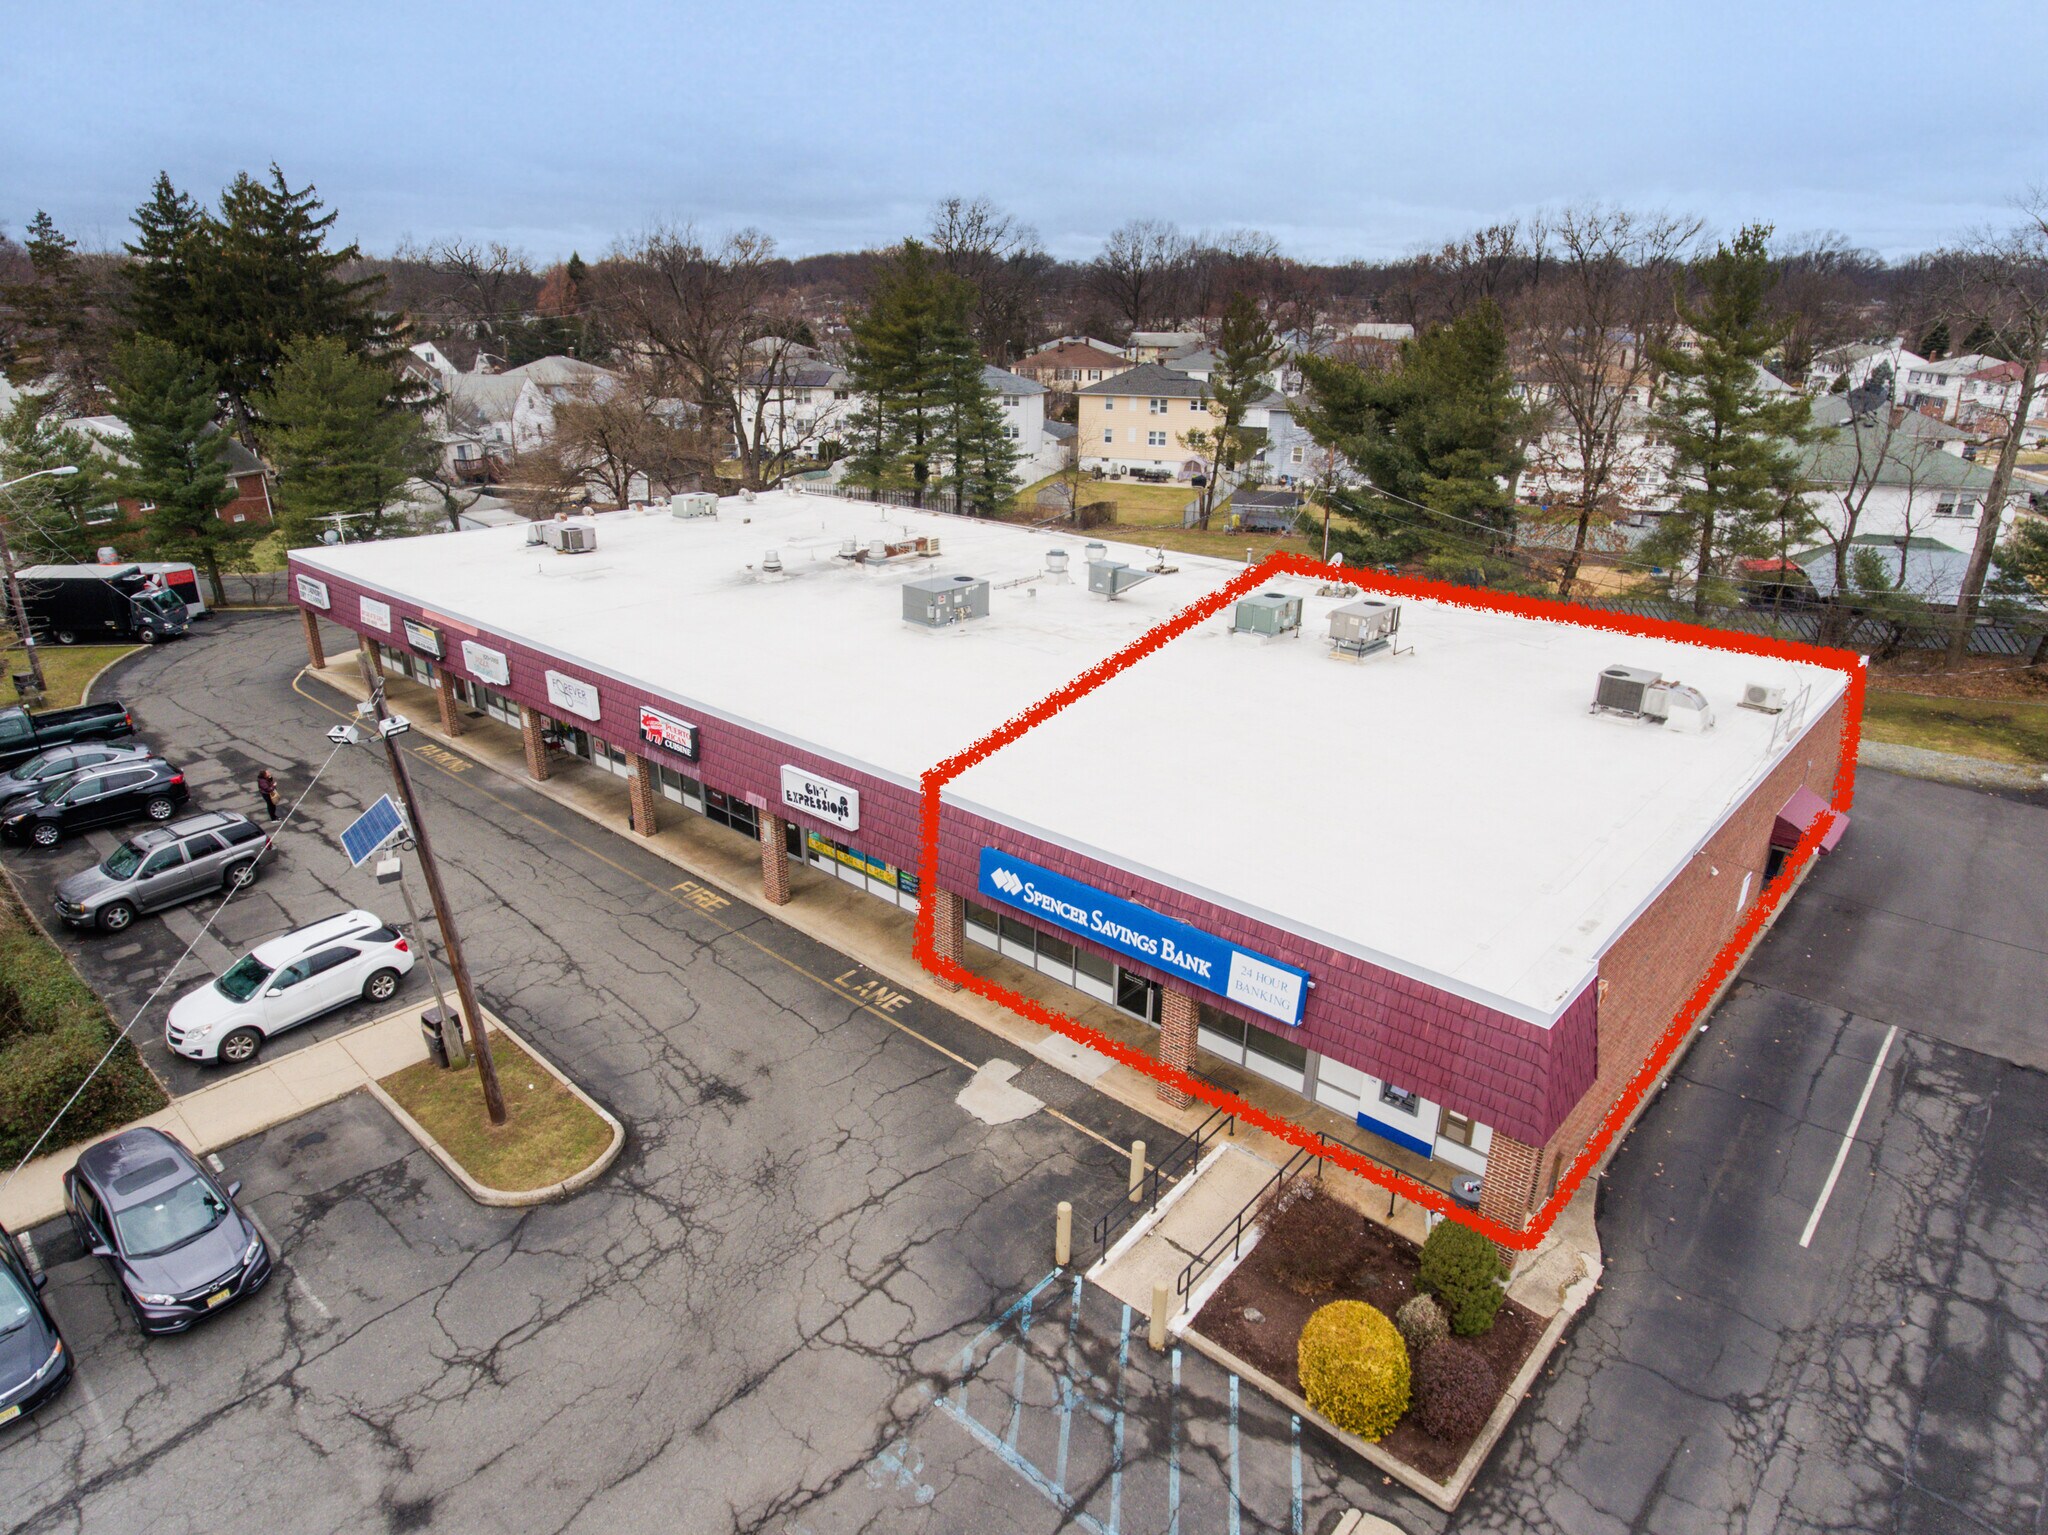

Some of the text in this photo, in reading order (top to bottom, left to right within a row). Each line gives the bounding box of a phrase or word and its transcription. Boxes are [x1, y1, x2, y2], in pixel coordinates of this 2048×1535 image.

[552, 678, 587, 705] FOREVER
[665, 723, 692, 740] PUERTO
[666, 732, 687, 745] RICAN
[414, 744, 474, 773] PARKING
[665, 740, 692, 756] CUISINE
[786, 790, 849, 818] EXPRESSIONS
[670, 880, 732, 914] FIRE
[1023, 882, 1213, 978] SPENCER SAVINGS BANK
[834, 969, 912, 1014] LANE
[1240, 966, 1289, 993] 24 HOUR
[1235, 980, 1291, 1010] BANKING
